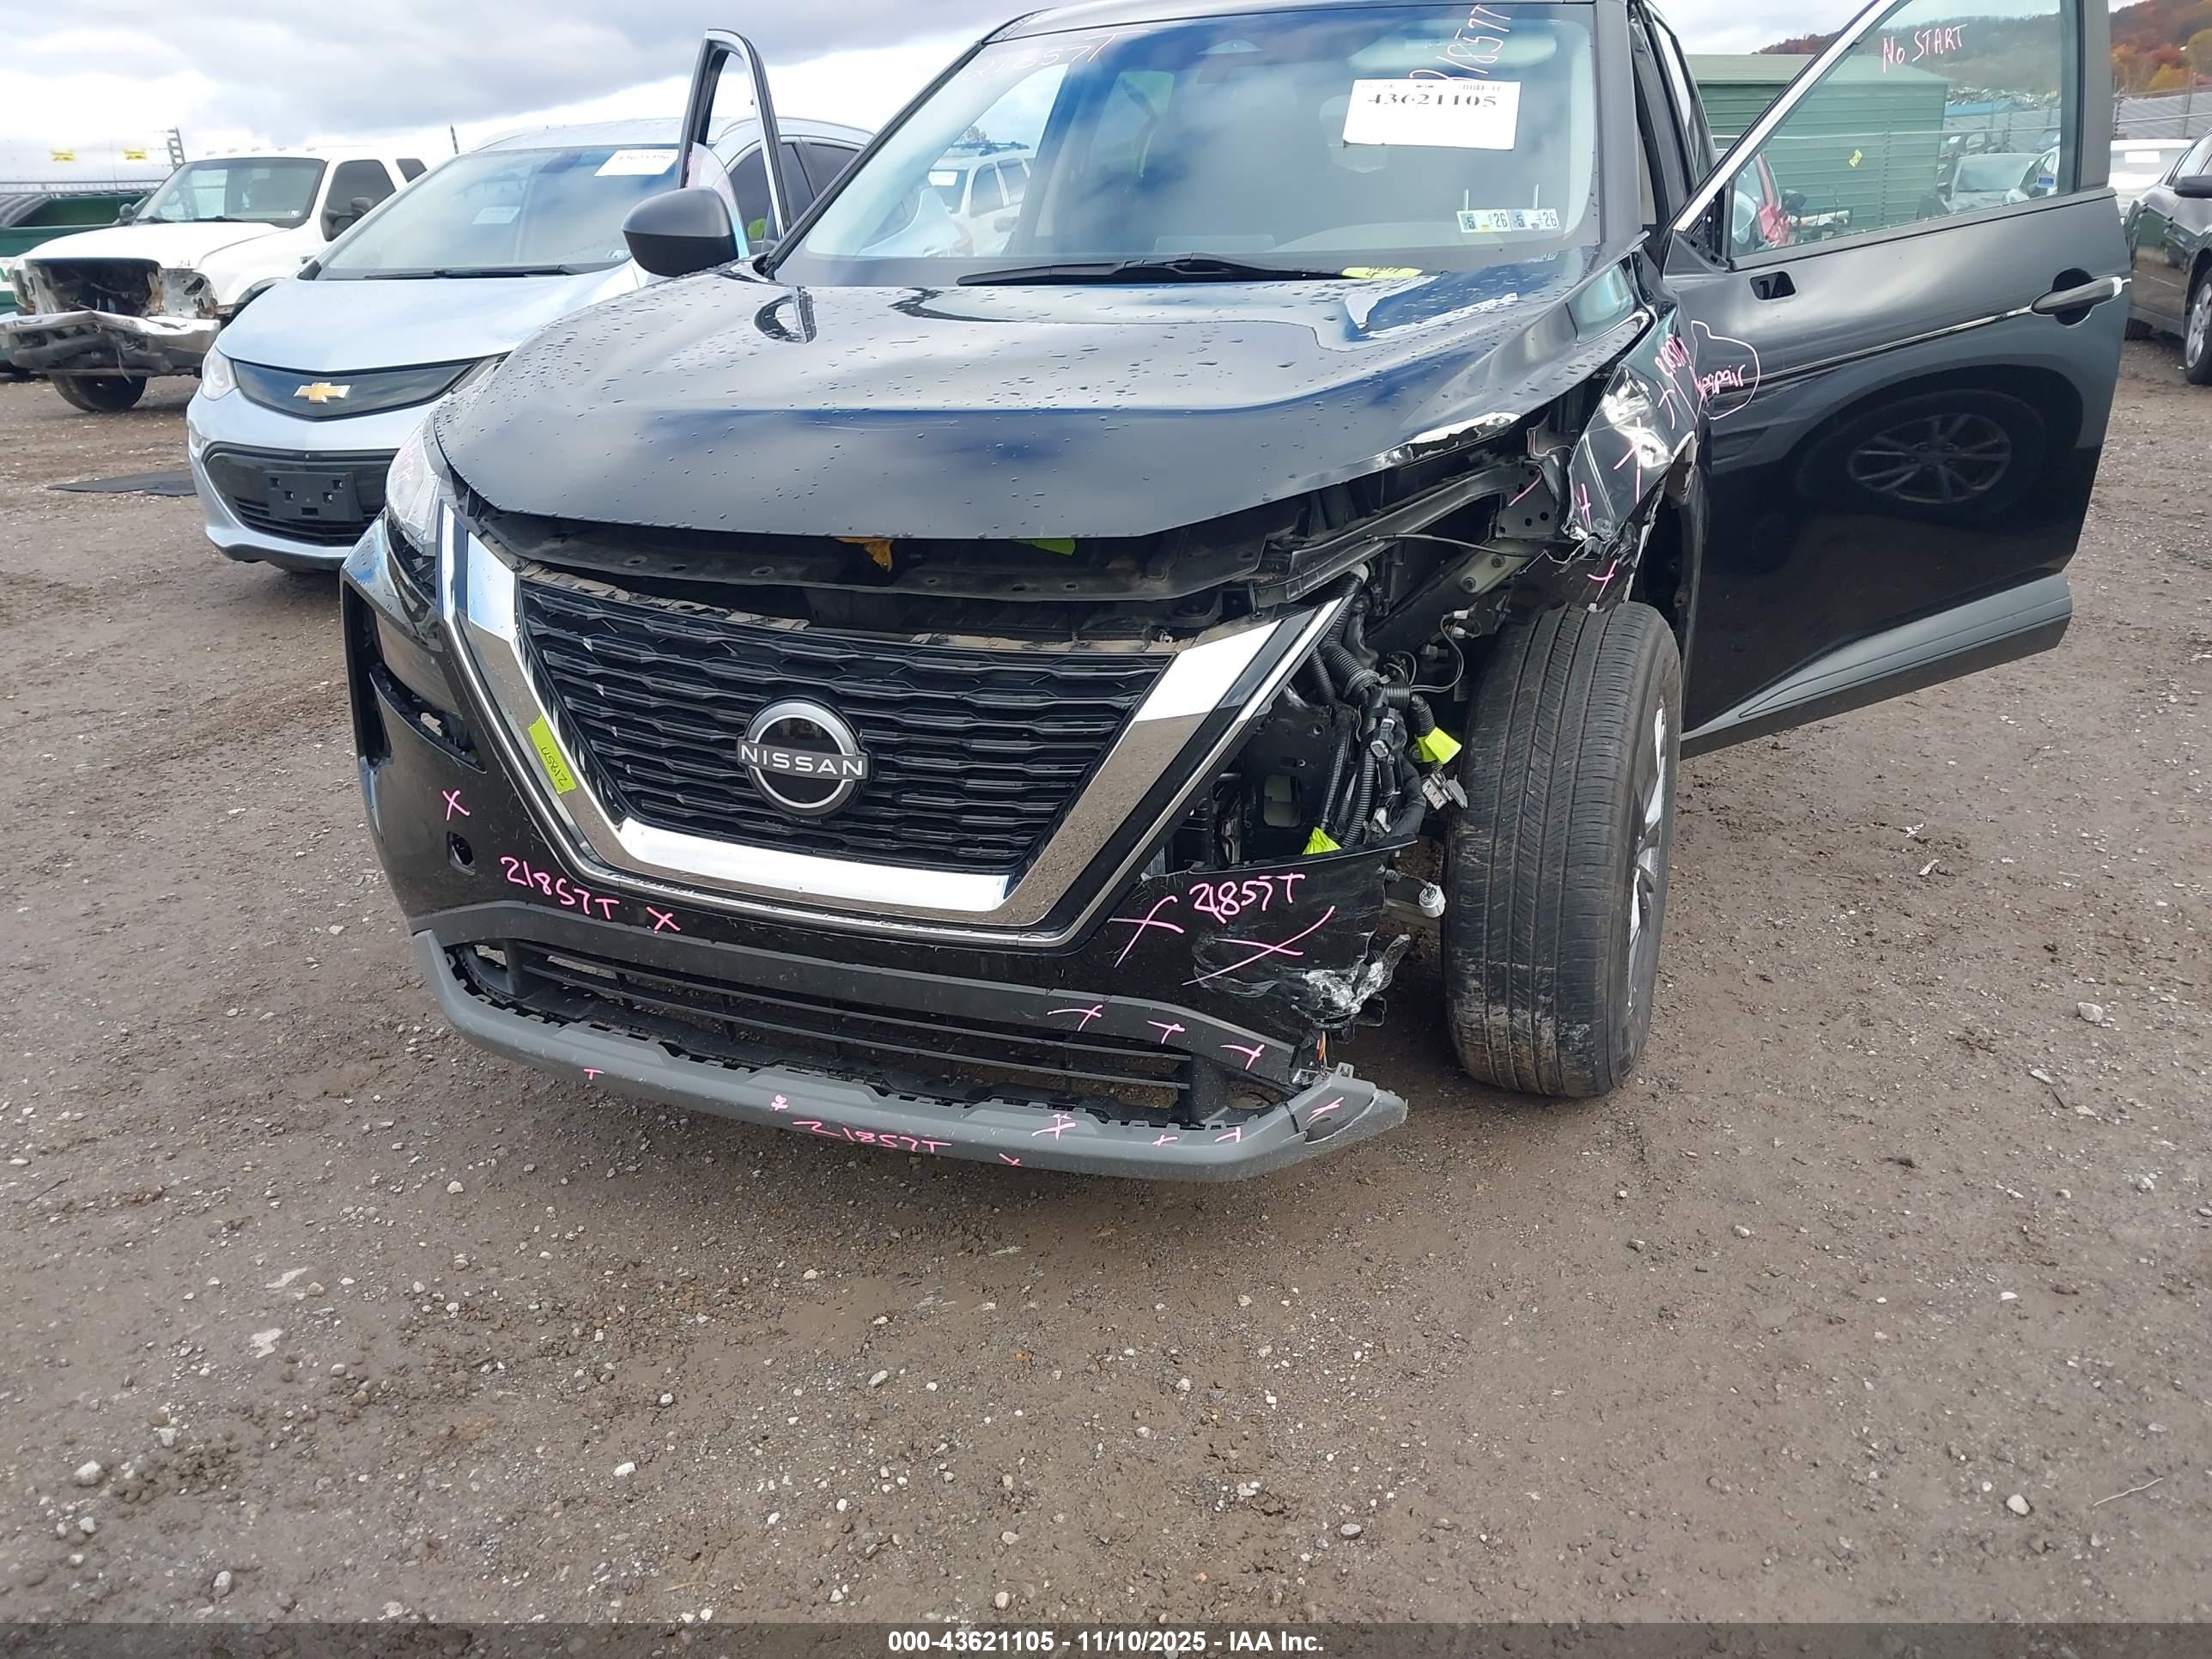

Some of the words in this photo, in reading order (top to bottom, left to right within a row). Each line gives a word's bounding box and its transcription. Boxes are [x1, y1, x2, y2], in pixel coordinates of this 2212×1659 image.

[1911, 22, 1968, 63] START
[1367, 93, 1497, 108] 43621105
[740, 744, 863, 776] NISSAN
